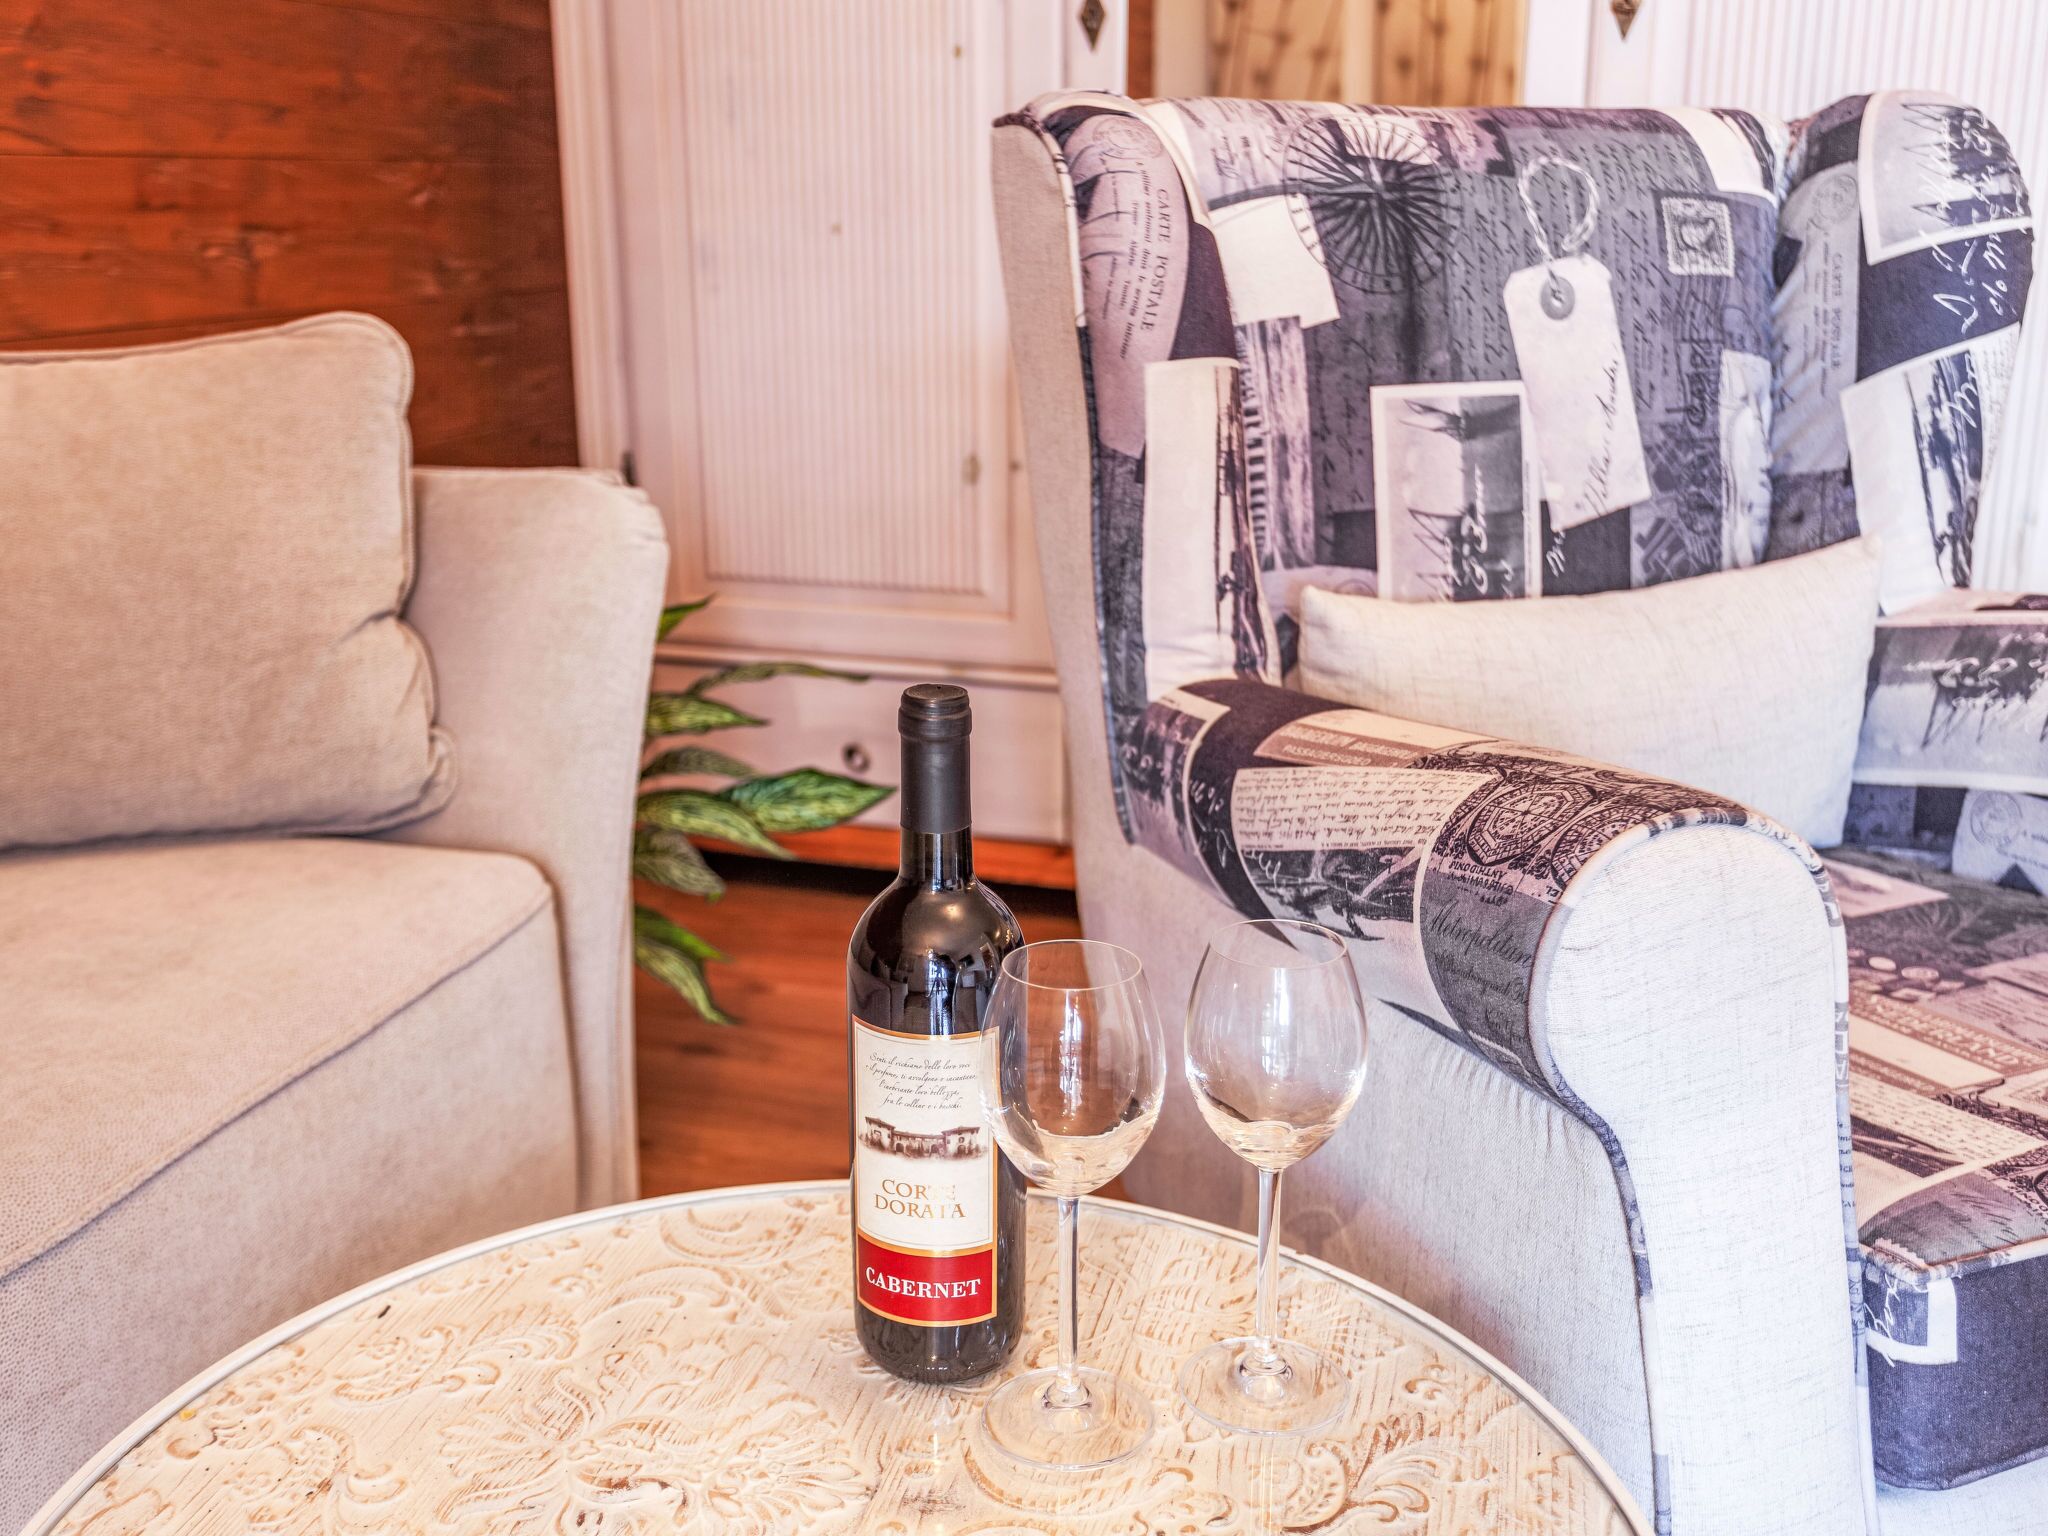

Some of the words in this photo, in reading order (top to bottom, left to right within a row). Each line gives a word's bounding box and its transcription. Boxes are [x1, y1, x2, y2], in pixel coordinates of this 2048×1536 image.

[1156, 188, 1172, 244] CARTE
[1140, 254, 1169, 331] POSTALE
[874, 1194, 966, 1219] DORATA
[882, 1179, 956, 1201] CORE
[865, 1266, 981, 1299] CABERNET
